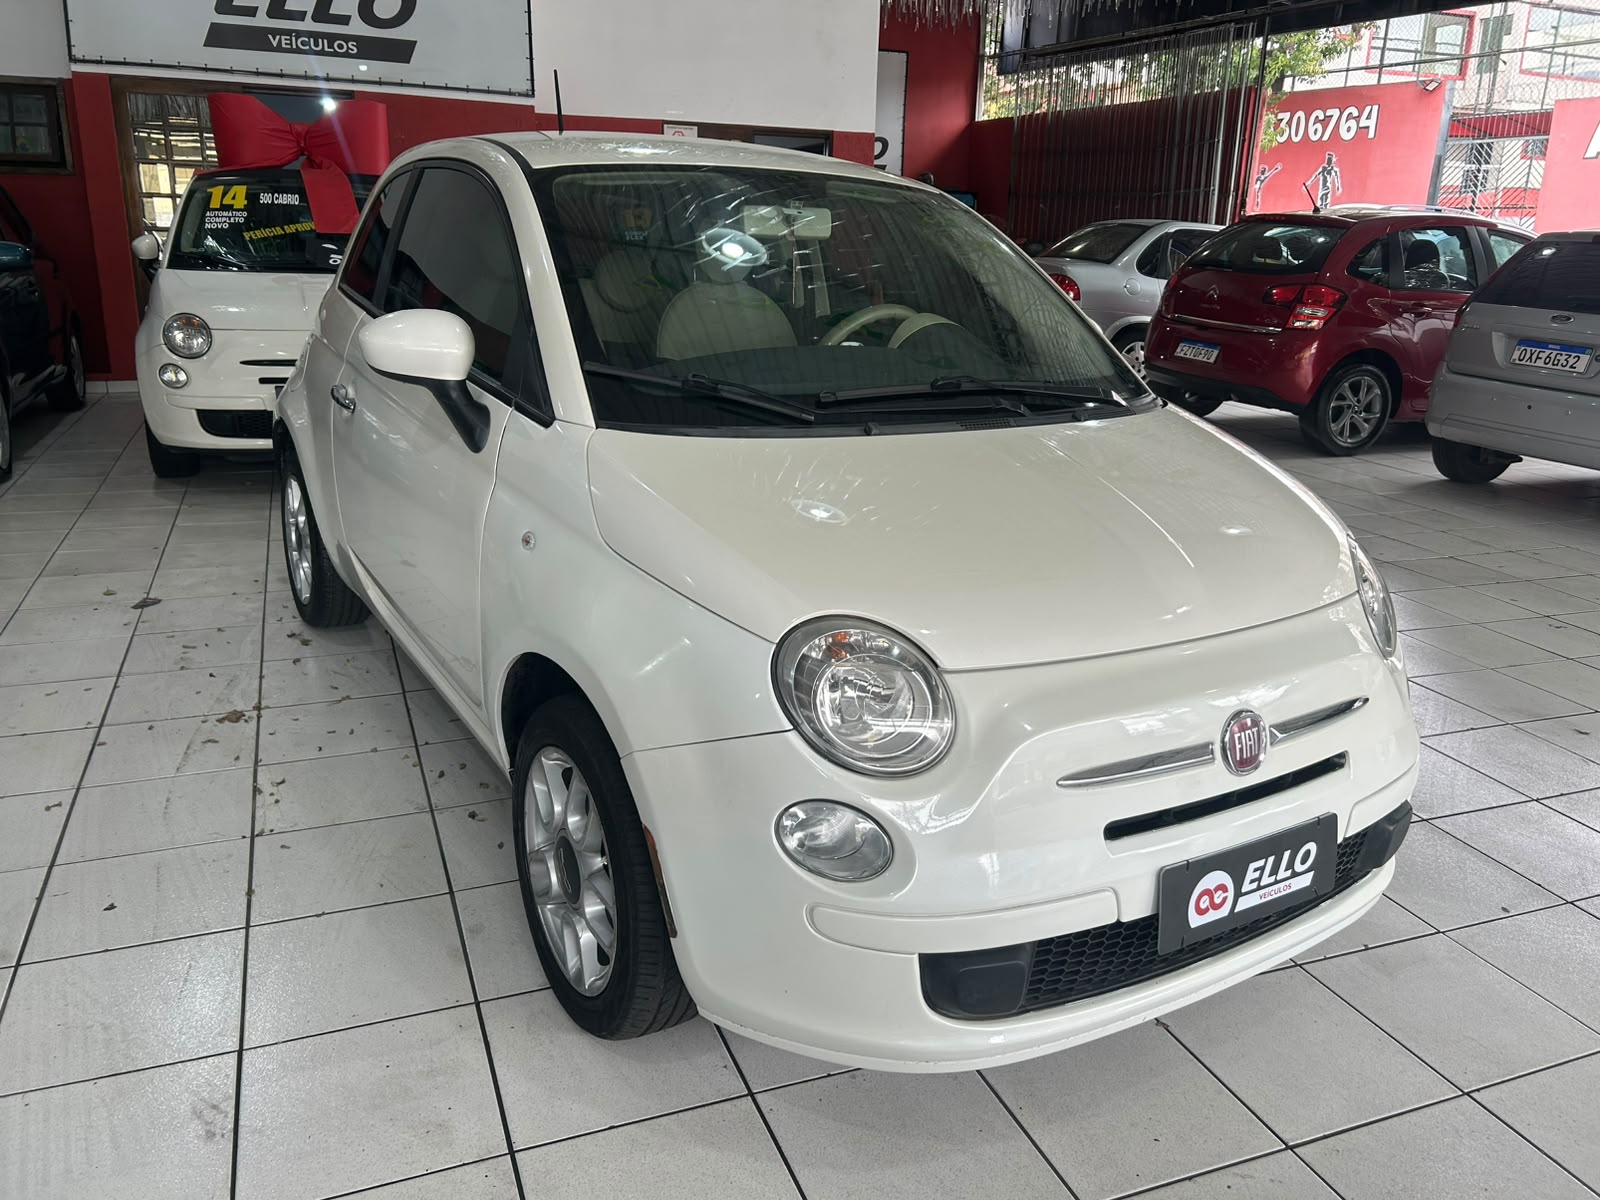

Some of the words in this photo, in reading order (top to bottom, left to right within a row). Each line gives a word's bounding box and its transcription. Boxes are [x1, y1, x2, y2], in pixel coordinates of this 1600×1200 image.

[267, 33, 358, 54] VEÍCULOS
[207, 185, 248, 209] 14
[259, 193, 273, 204] 500
[273, 193, 300, 205] CABRIO
[243, 226, 285, 241] PERÍCIA
[1517, 348, 1581, 370] OXF6G32
[1234, 727, 1259, 761] FIAT
[1241, 841, 1317, 893] ELLO
[1258, 883, 1292, 901] VEÍCULOS
